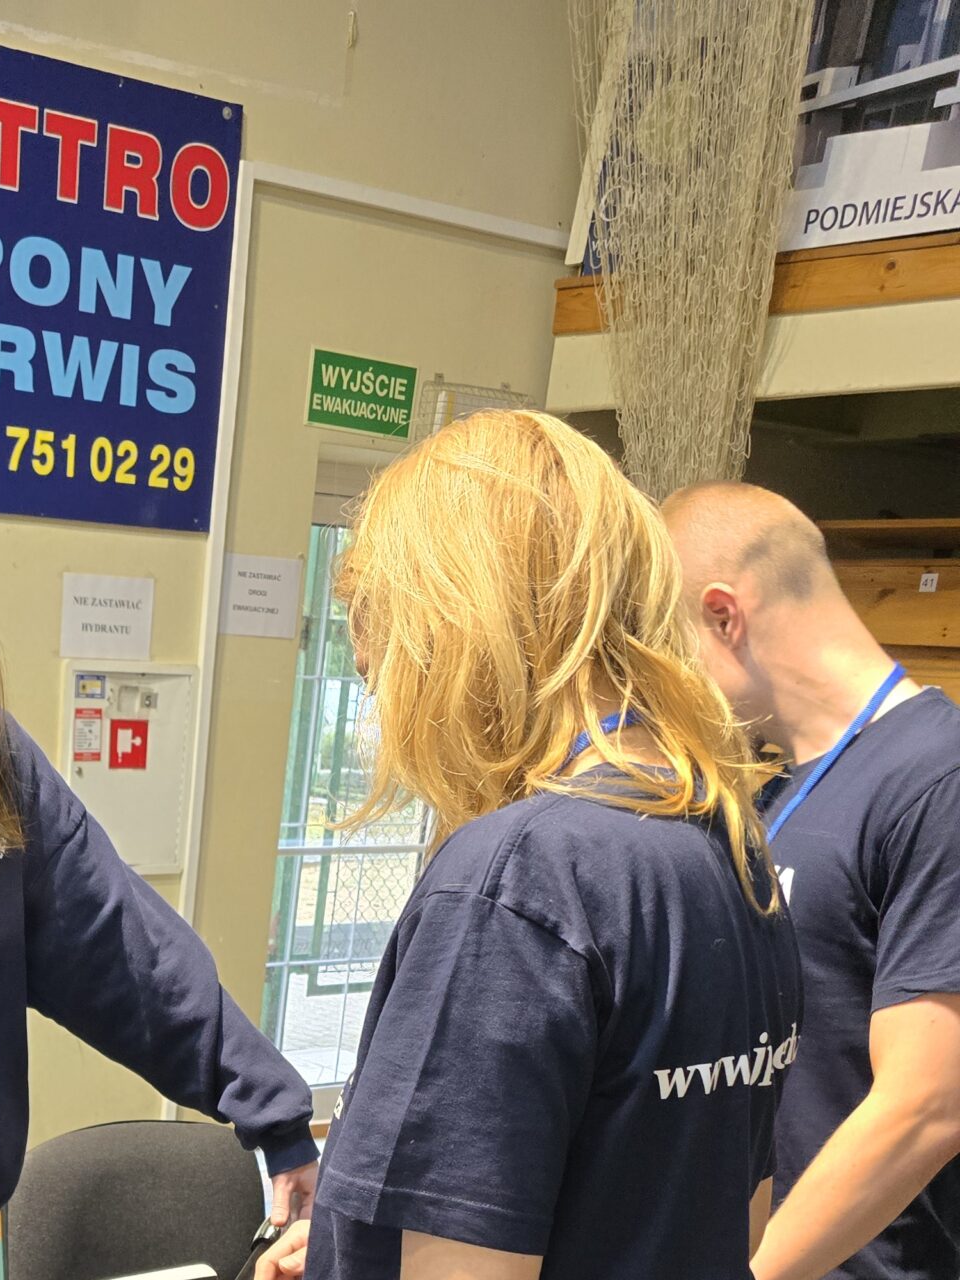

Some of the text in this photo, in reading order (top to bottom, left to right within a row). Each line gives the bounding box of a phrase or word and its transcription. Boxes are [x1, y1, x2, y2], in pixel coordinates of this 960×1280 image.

[321, 363, 408, 401] WYJŚCIE
[312, 393, 409, 425] EWAKUACYJNE
[5, 425, 77, 478] 751
[90, 436, 138, 486] 02
[148, 444, 195, 492] 29
[921, 578, 935, 588] 41
[73, 595, 143, 611] NIE ZASTAWIAĆ
[81, 622, 131, 635] HYDRANTU
